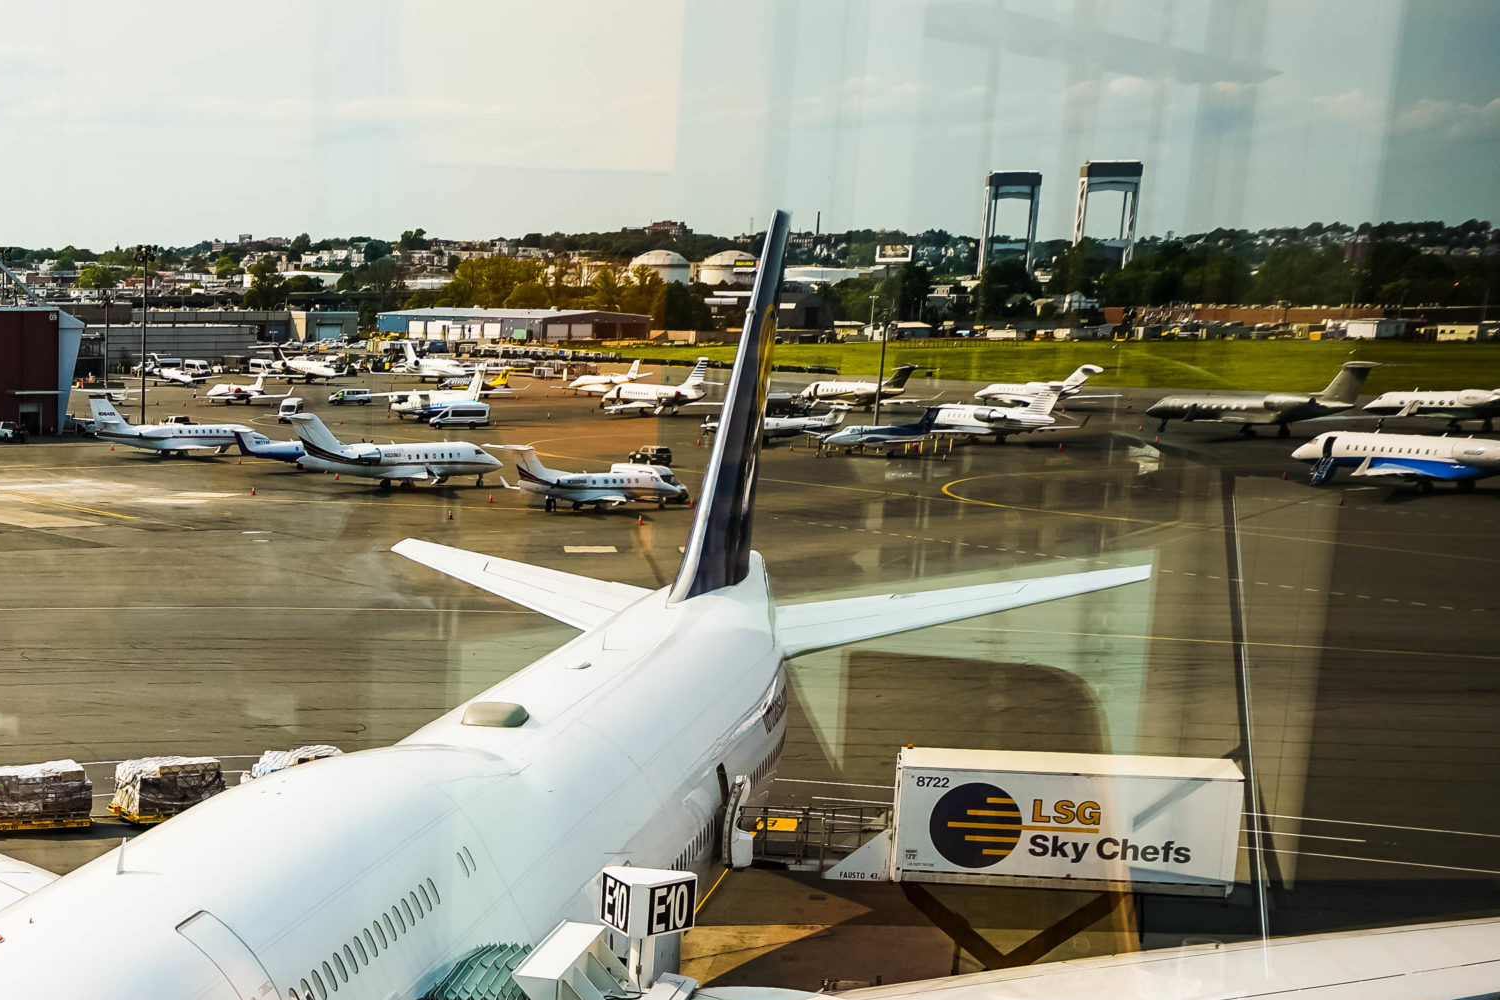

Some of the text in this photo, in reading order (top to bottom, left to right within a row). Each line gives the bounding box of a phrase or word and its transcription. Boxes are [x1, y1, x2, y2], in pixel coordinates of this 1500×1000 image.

[916, 776, 950, 789] 8722
[1031, 799, 1102, 826] LSG
[1028, 834, 1192, 865] Sky Chefs
[839, 871, 866, 880] FAUSTO
[604, 876, 628, 930] E10
[652, 883, 689, 934] E10
